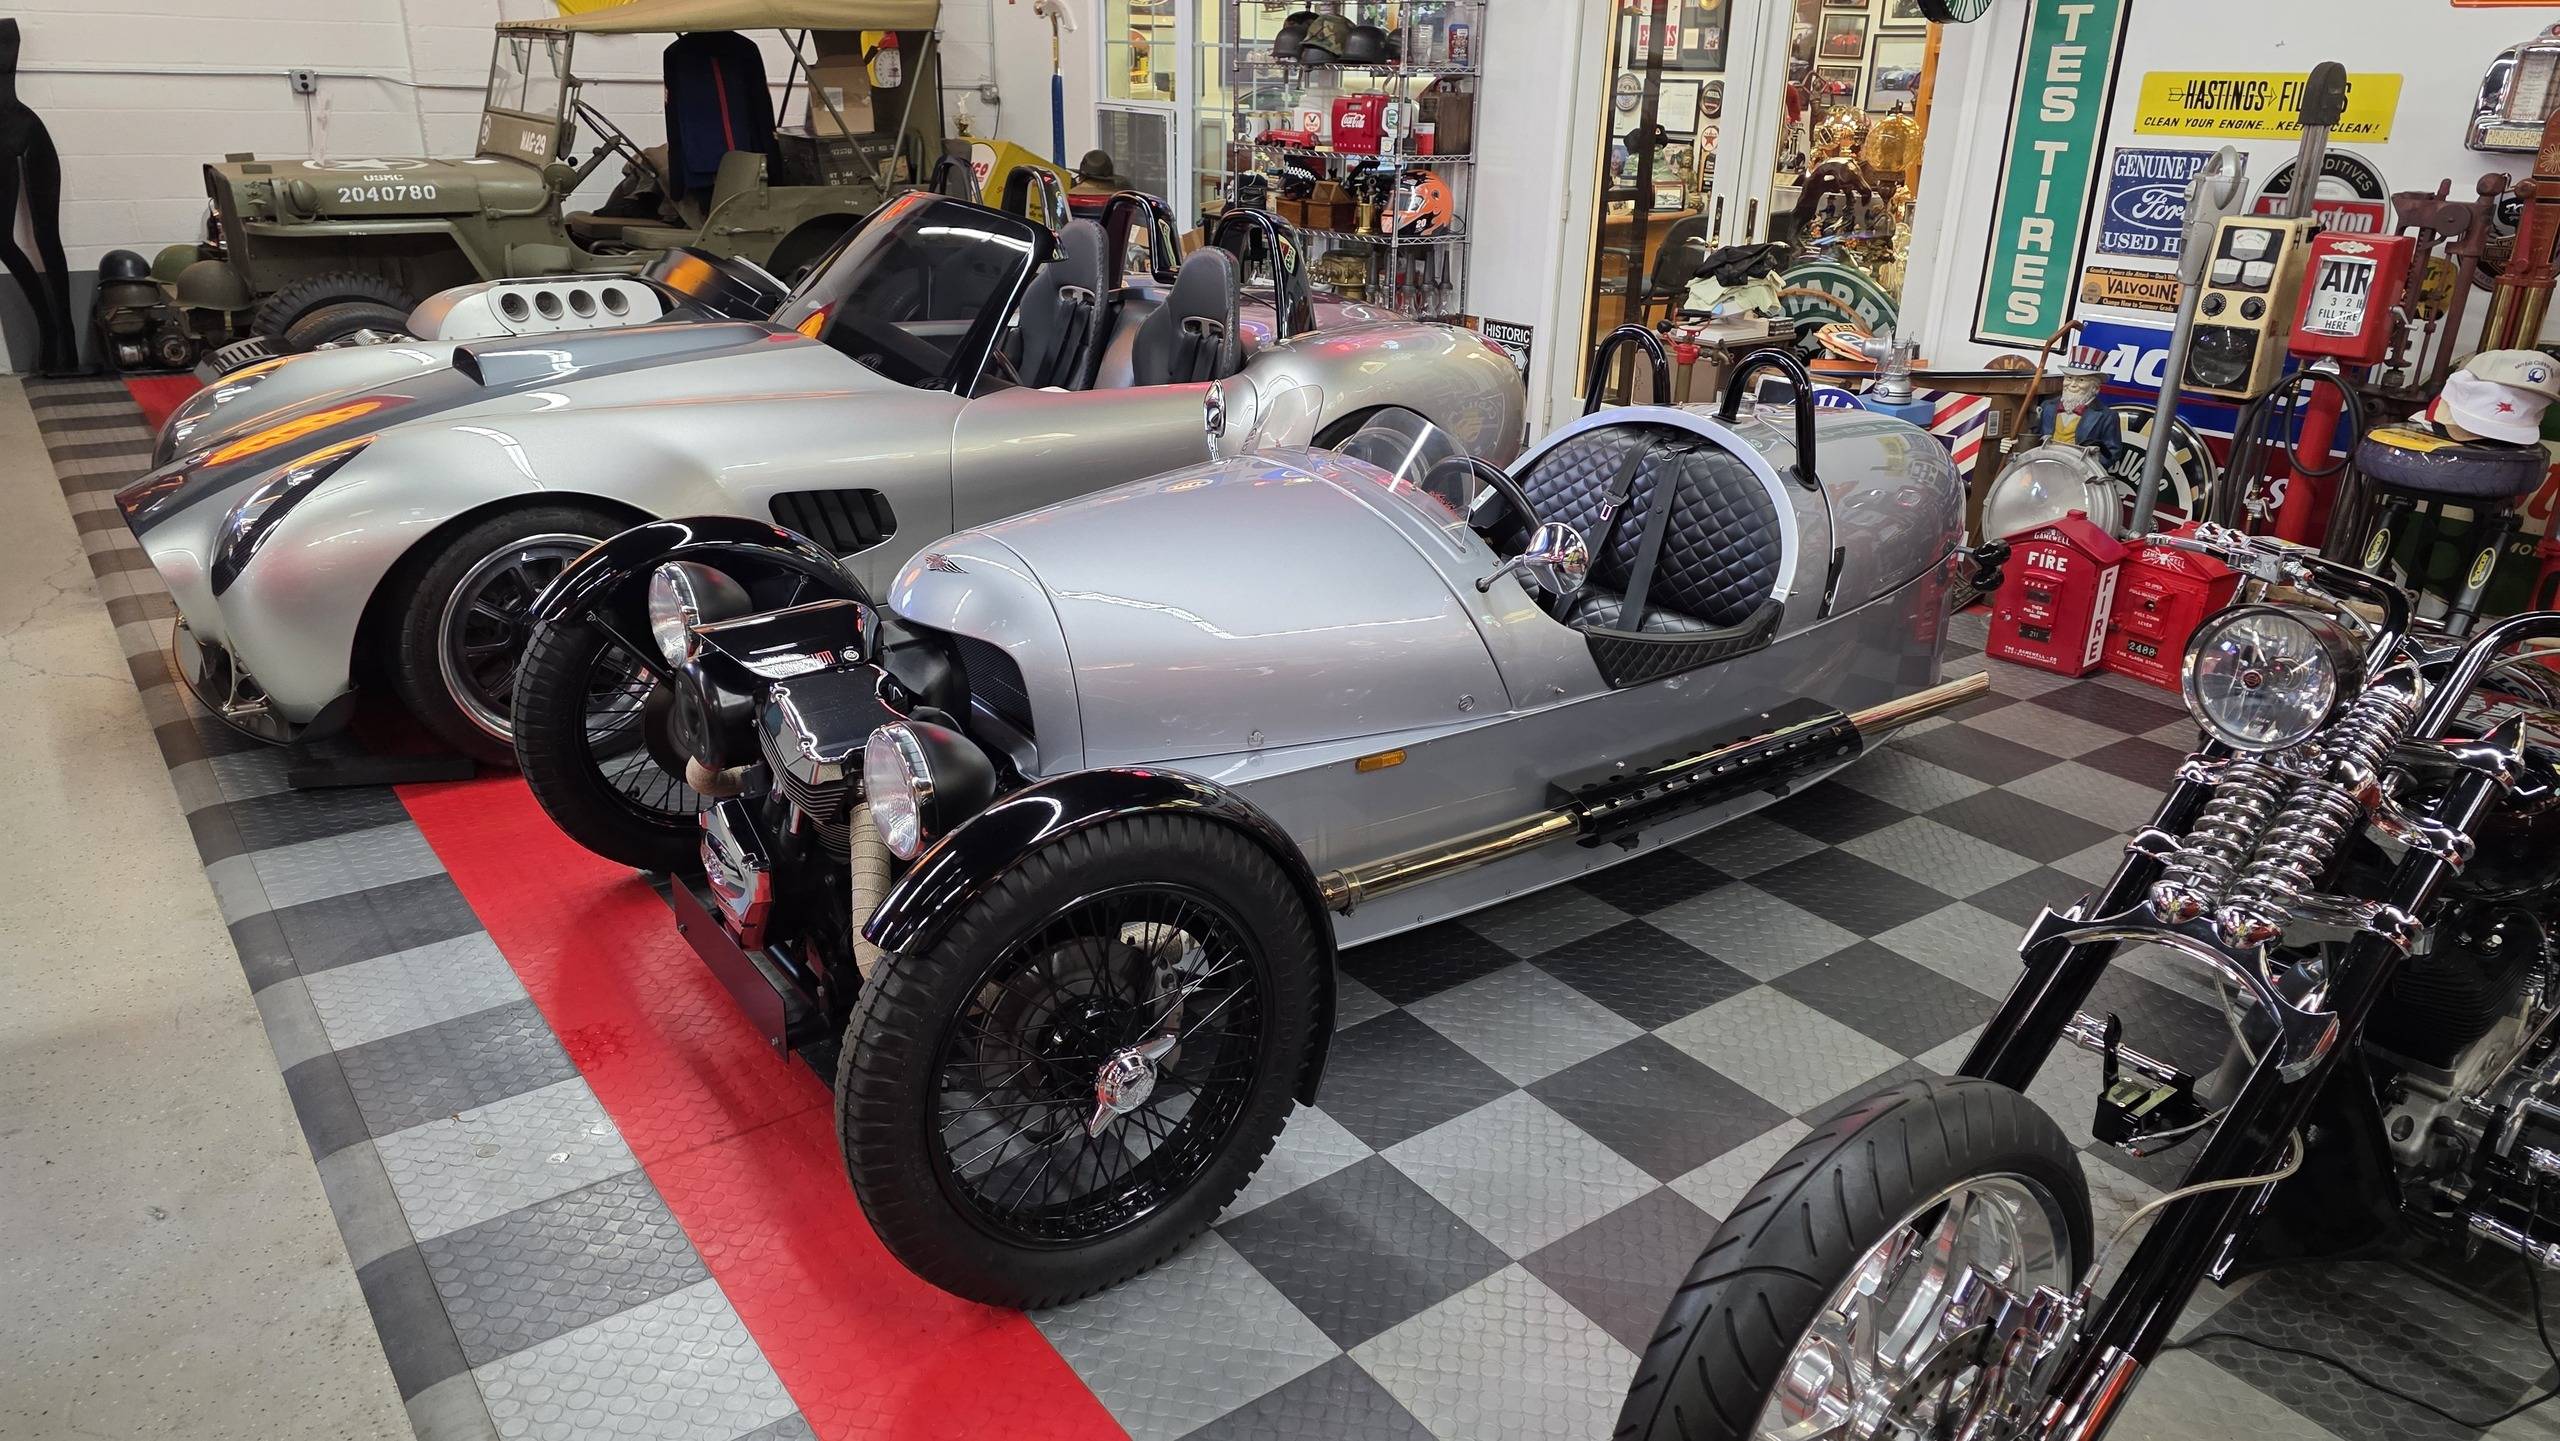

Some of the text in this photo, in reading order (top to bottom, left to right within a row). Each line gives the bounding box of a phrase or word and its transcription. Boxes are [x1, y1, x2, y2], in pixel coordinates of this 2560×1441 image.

[2183, 80, 2268, 111] HASTINGS
[2144, 116, 2179, 128] CLEAN
[2185, 118, 2214, 129] YOUR
[2115, 153, 2187, 179] GENUINE
[363, 174, 404, 182] USMC
[337, 185, 437, 203] 2040780
[2131, 188, 2184, 221] For
[1415, 219, 1427, 228] 20
[2006, 140, 2069, 325] TIRES
[2104, 231, 2158, 251] USED
[2320, 262, 2373, 294] AIR
[2107, 276, 2179, 304] VALVOLINE
[2318, 309, 2358, 321] FILL TIRE
[2325, 320, 2348, 330] HERE
[1486, 323, 1530, 343] HISTORIC
[2034, 532, 2071, 546] GAMEWELL
[2027, 551, 2069, 572] FIRE
[2088, 571, 2113, 661] FIRE
[2128, 641, 2155, 657] 2488
